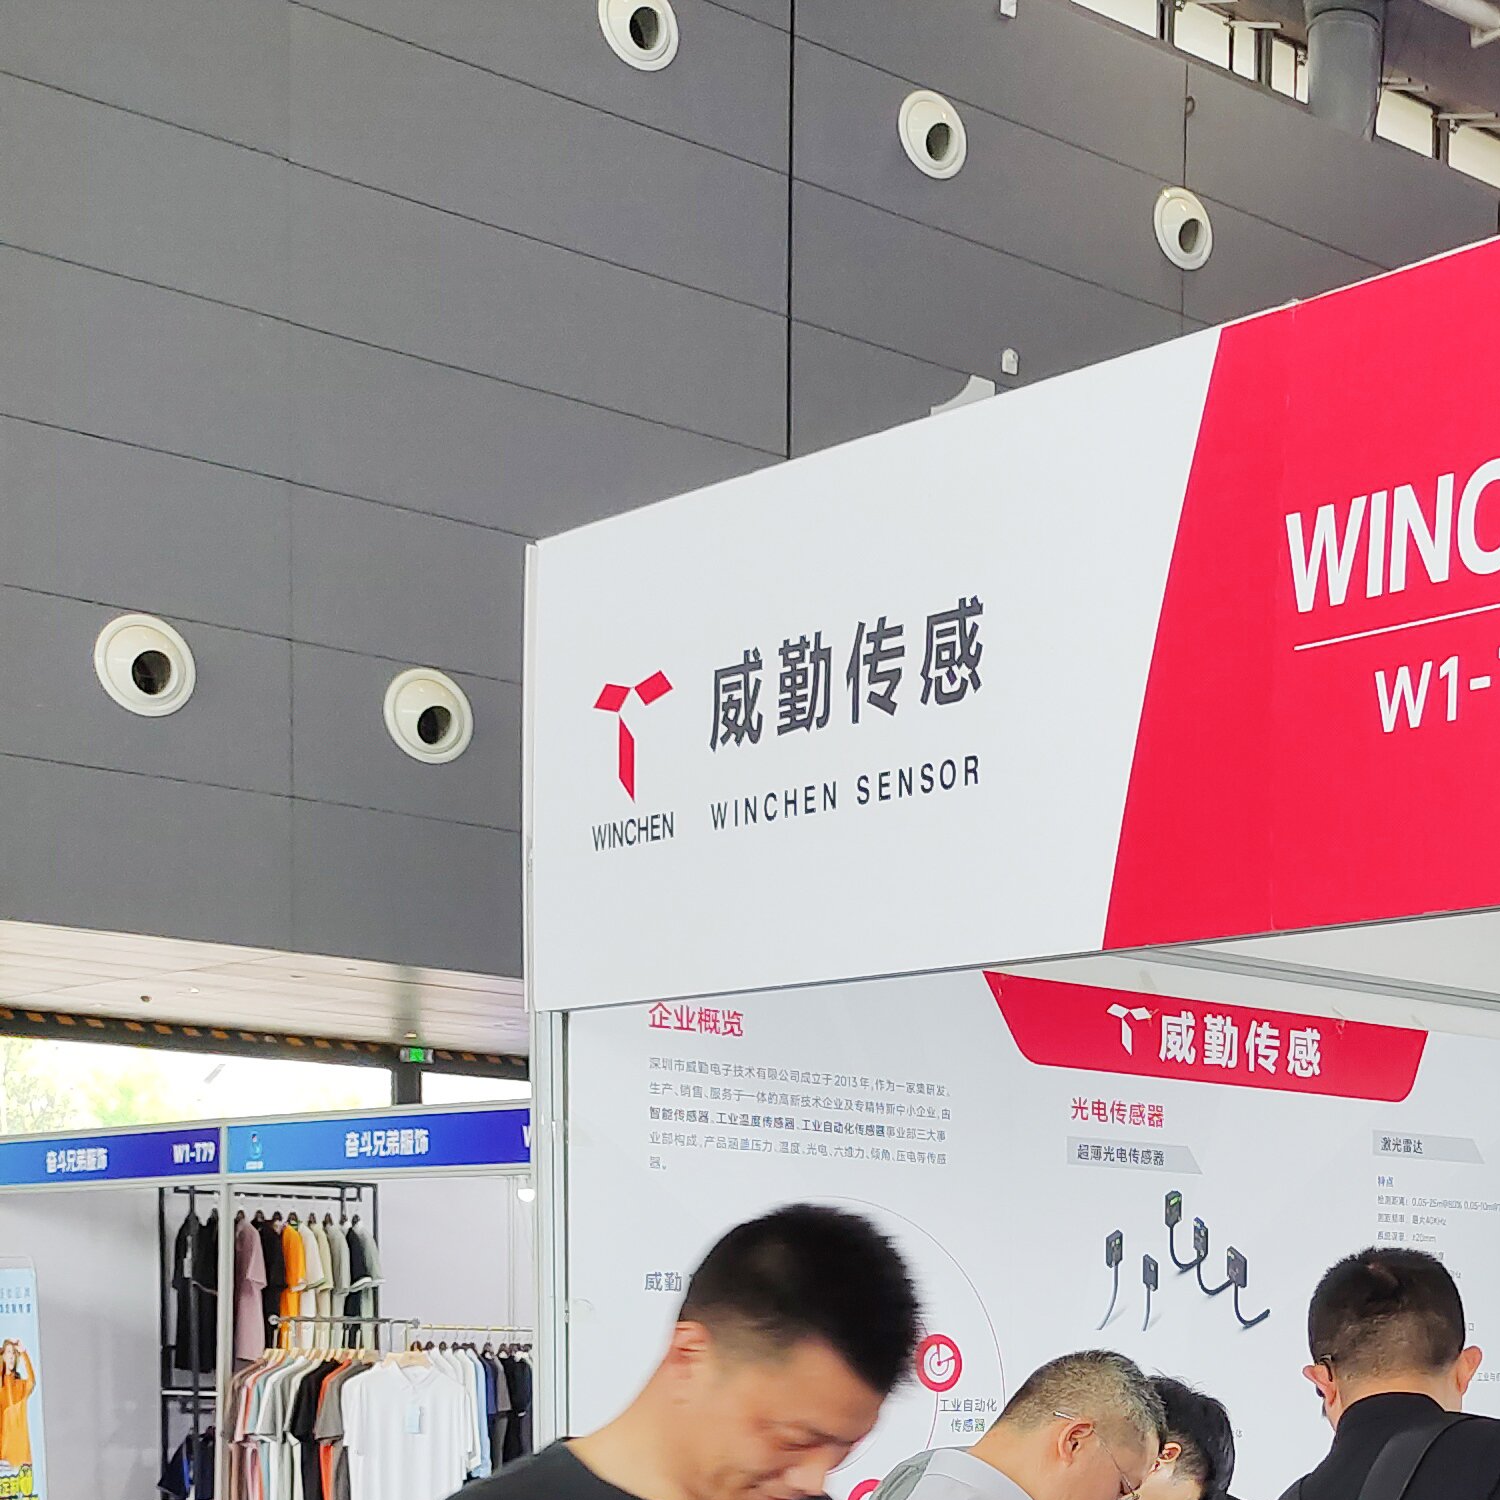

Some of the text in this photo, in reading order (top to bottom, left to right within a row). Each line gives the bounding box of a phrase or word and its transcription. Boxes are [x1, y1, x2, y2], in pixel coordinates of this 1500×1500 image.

[709, 595, 985, 753] 威勤传感
[711, 754, 981, 831] WINCHEN SENSOR
[592, 810, 675, 852] WINCHEN
[648, 1001, 744, 1037] 企业概览
[1158, 1011, 1322, 1078] 威勤传感
[1070, 1096, 1165, 1129] 光电传感器
[172, 1141, 215, 1165] W1-T79
[1077, 1143, 1165, 1167] 超薄光电传感器
[1380, 1136, 1424, 1154] 激光雷达
[939, 1397, 998, 1413] 工业自动化
[950, 1417, 986, 1434] 传感器
